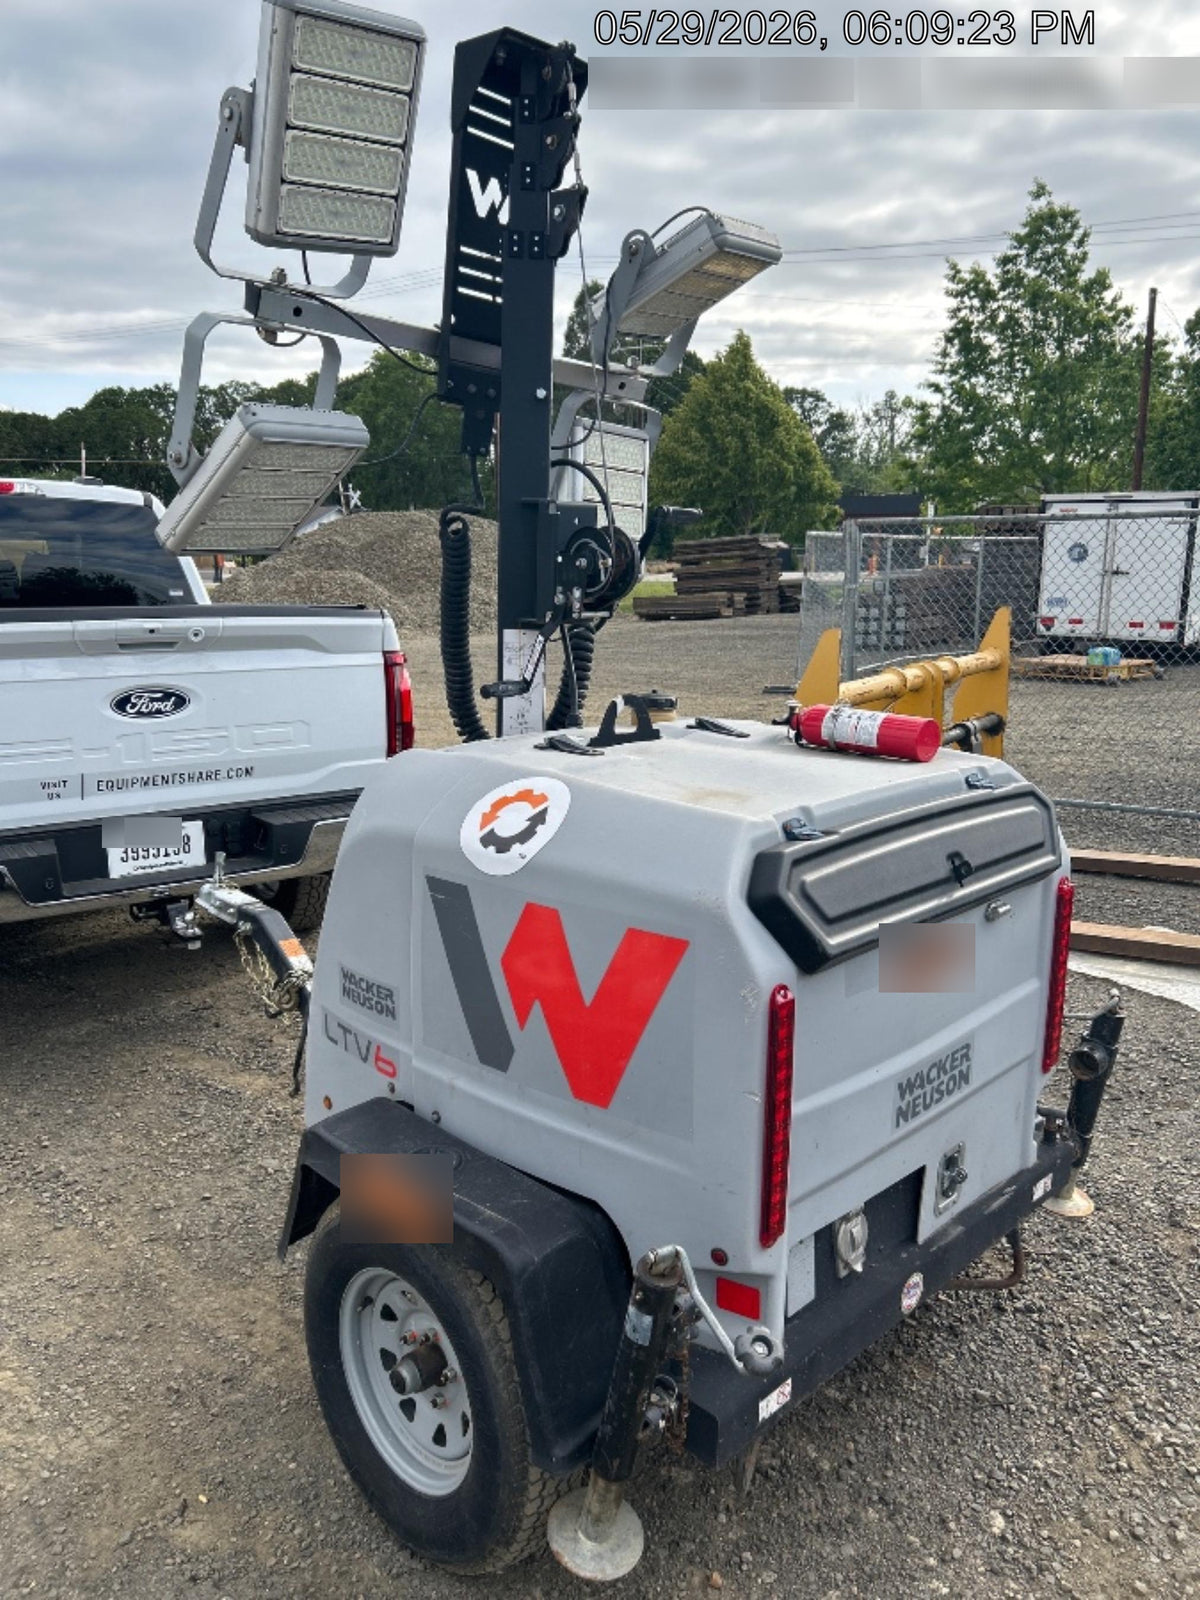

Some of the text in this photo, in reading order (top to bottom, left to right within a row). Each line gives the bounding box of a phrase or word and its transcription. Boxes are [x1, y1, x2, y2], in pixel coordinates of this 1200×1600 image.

[126, 692, 176, 713] Ford
[40, 779, 68, 790] VISIT
[96, 766, 255, 792] EQUIPMENTSHARE.COM
[341, 966, 396, 1005] WACKER
[342, 982, 397, 1020] NEUSON
[325, 1012, 398, 1078] LTV6
[897, 1042, 972, 1102] WACKER
[895, 1064, 971, 1129] NEUSON
